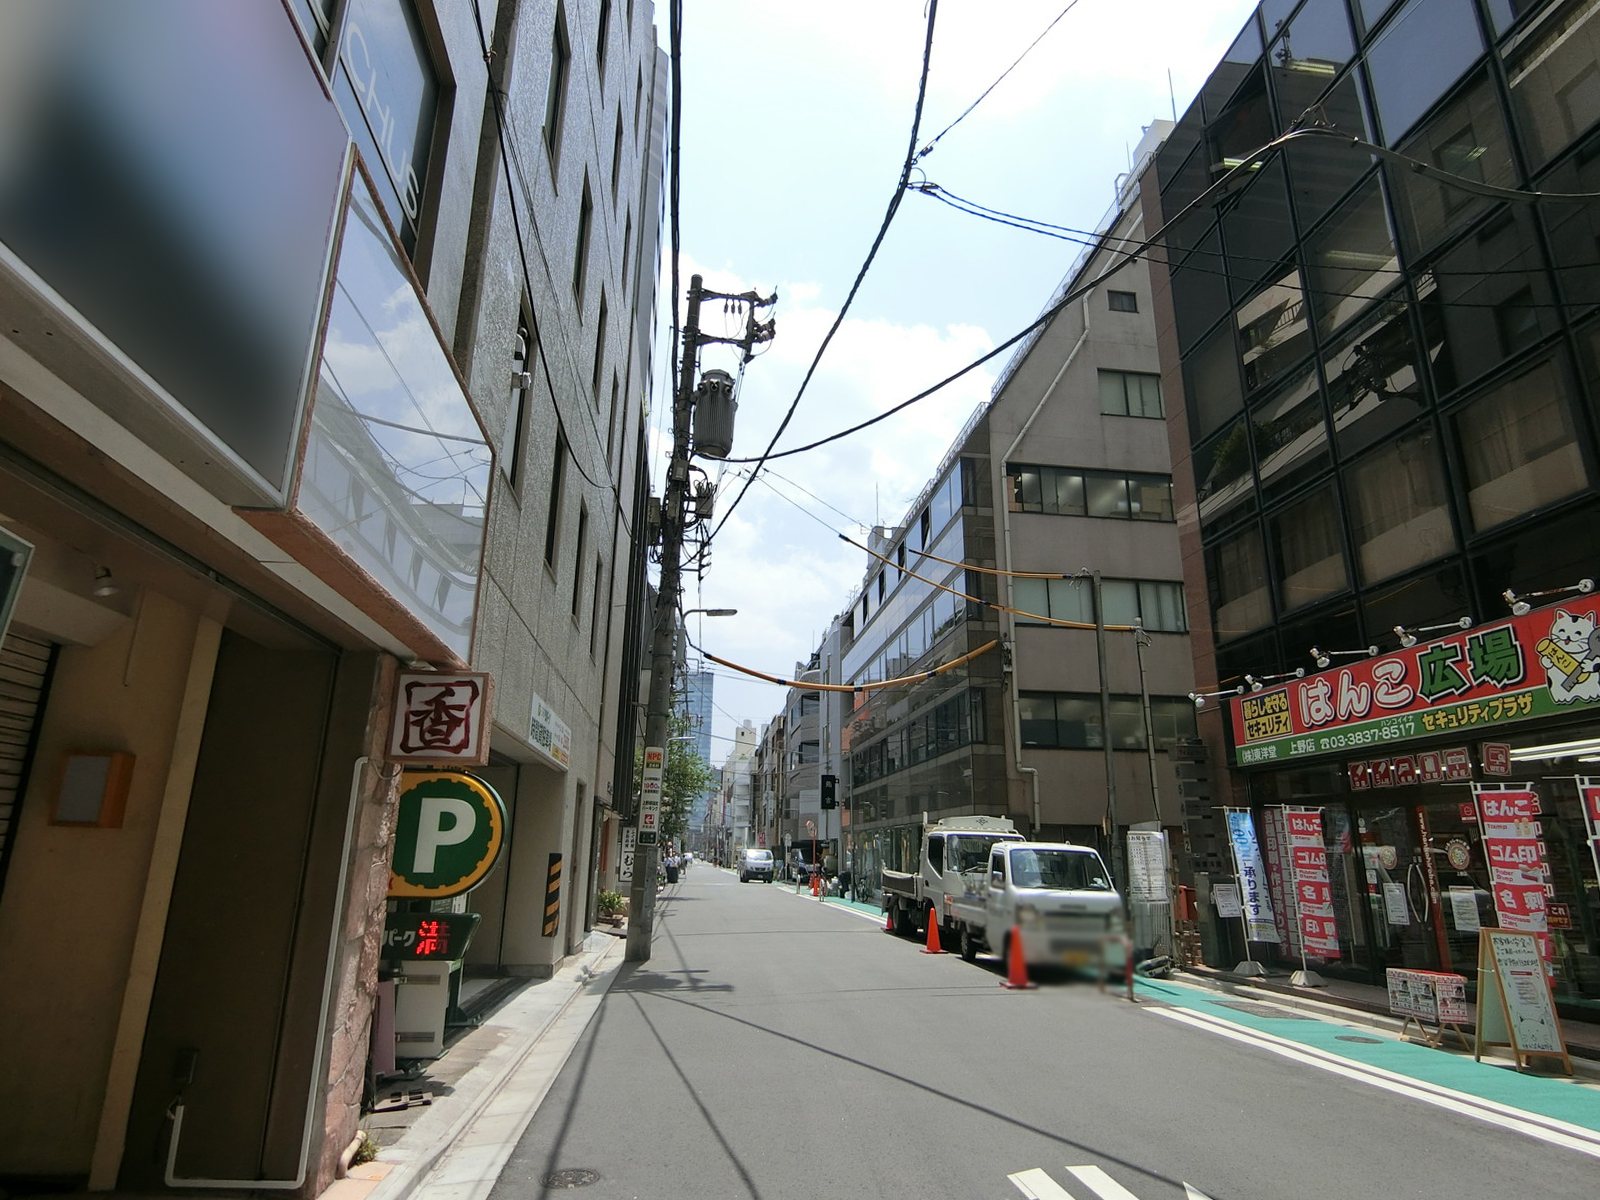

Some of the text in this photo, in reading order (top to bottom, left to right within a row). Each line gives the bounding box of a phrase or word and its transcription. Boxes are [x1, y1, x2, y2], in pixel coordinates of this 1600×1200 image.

[1299, 624, 1526, 728] はんこ広場
[1243, 692, 1288, 720] 暮らしを守る
[1422, 692, 1534, 732] セキュリティプラザ
[1247, 715, 1289, 738] セキュリティ
[646, 752, 662, 761] NPC
[1242, 745, 1278, 764] (株)東洋堂
[1289, 738, 1316, 755] 上野店
[1483, 799, 1531, 817] はんこ
[1291, 817, 1322, 831] はんこ
[412, 797, 477, 874] P
[1185, 840, 1190, 852] 2
[1490, 845, 1538, 864] ゴム印
[1499, 889, 1546, 910] 名刺
